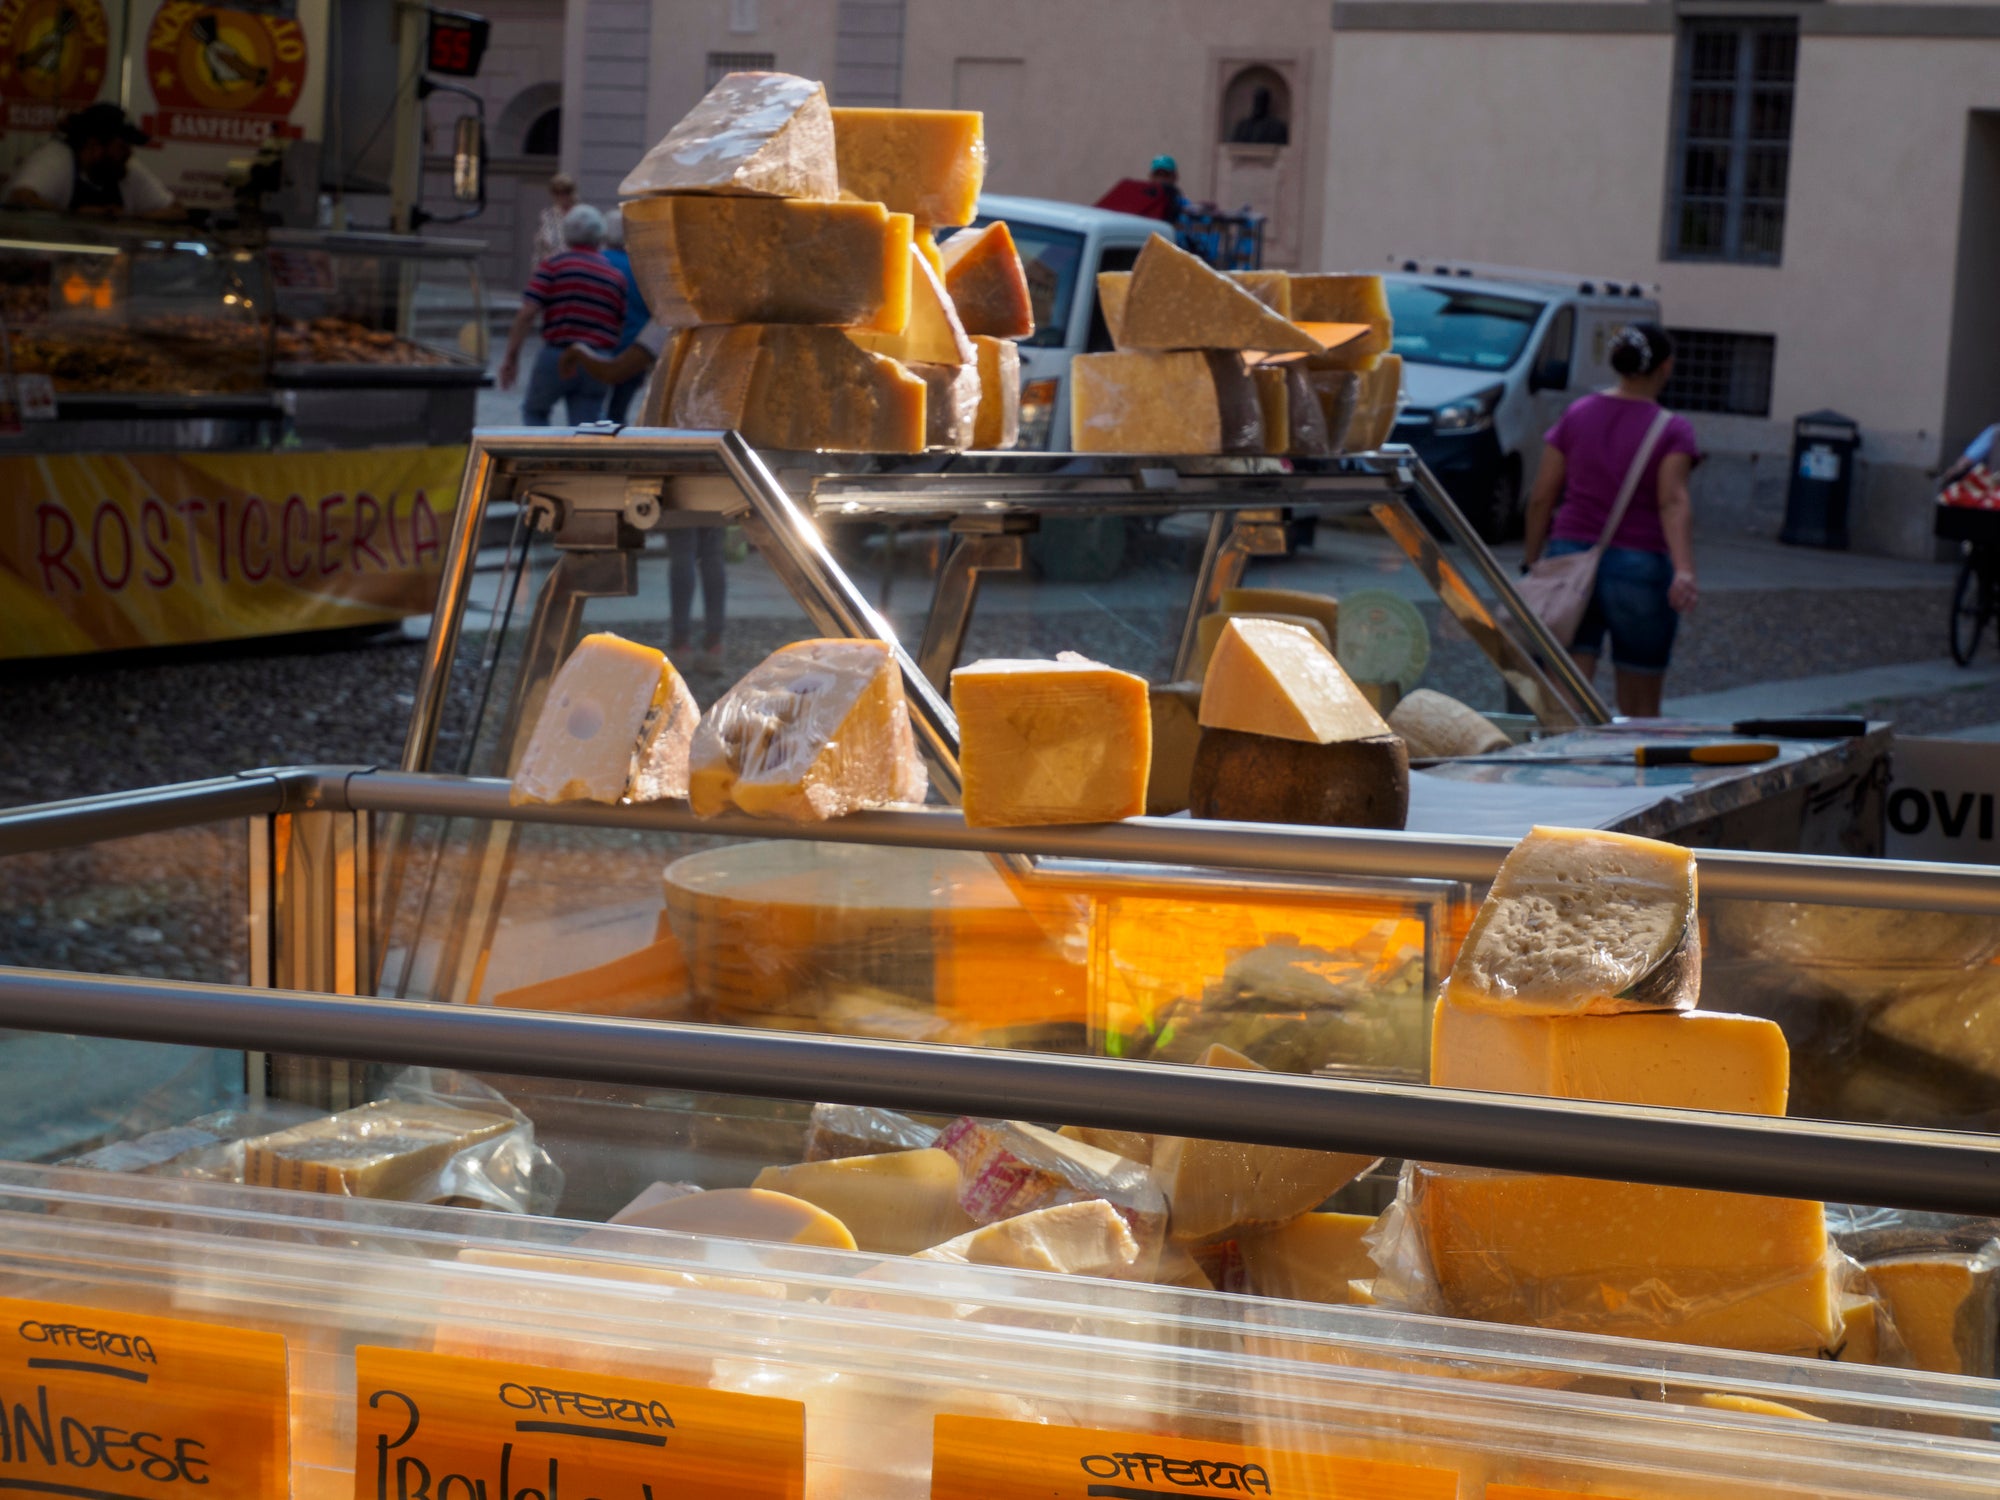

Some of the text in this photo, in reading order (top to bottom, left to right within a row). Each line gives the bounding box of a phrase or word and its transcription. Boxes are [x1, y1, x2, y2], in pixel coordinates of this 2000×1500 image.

[36, 489, 440, 593] ROSTICCERIA
[19, 1320, 157, 1364] OFFERTA
[499, 1382, 675, 1429] OFFERTA
[1080, 1452, 1272, 1495] OFFERTA
